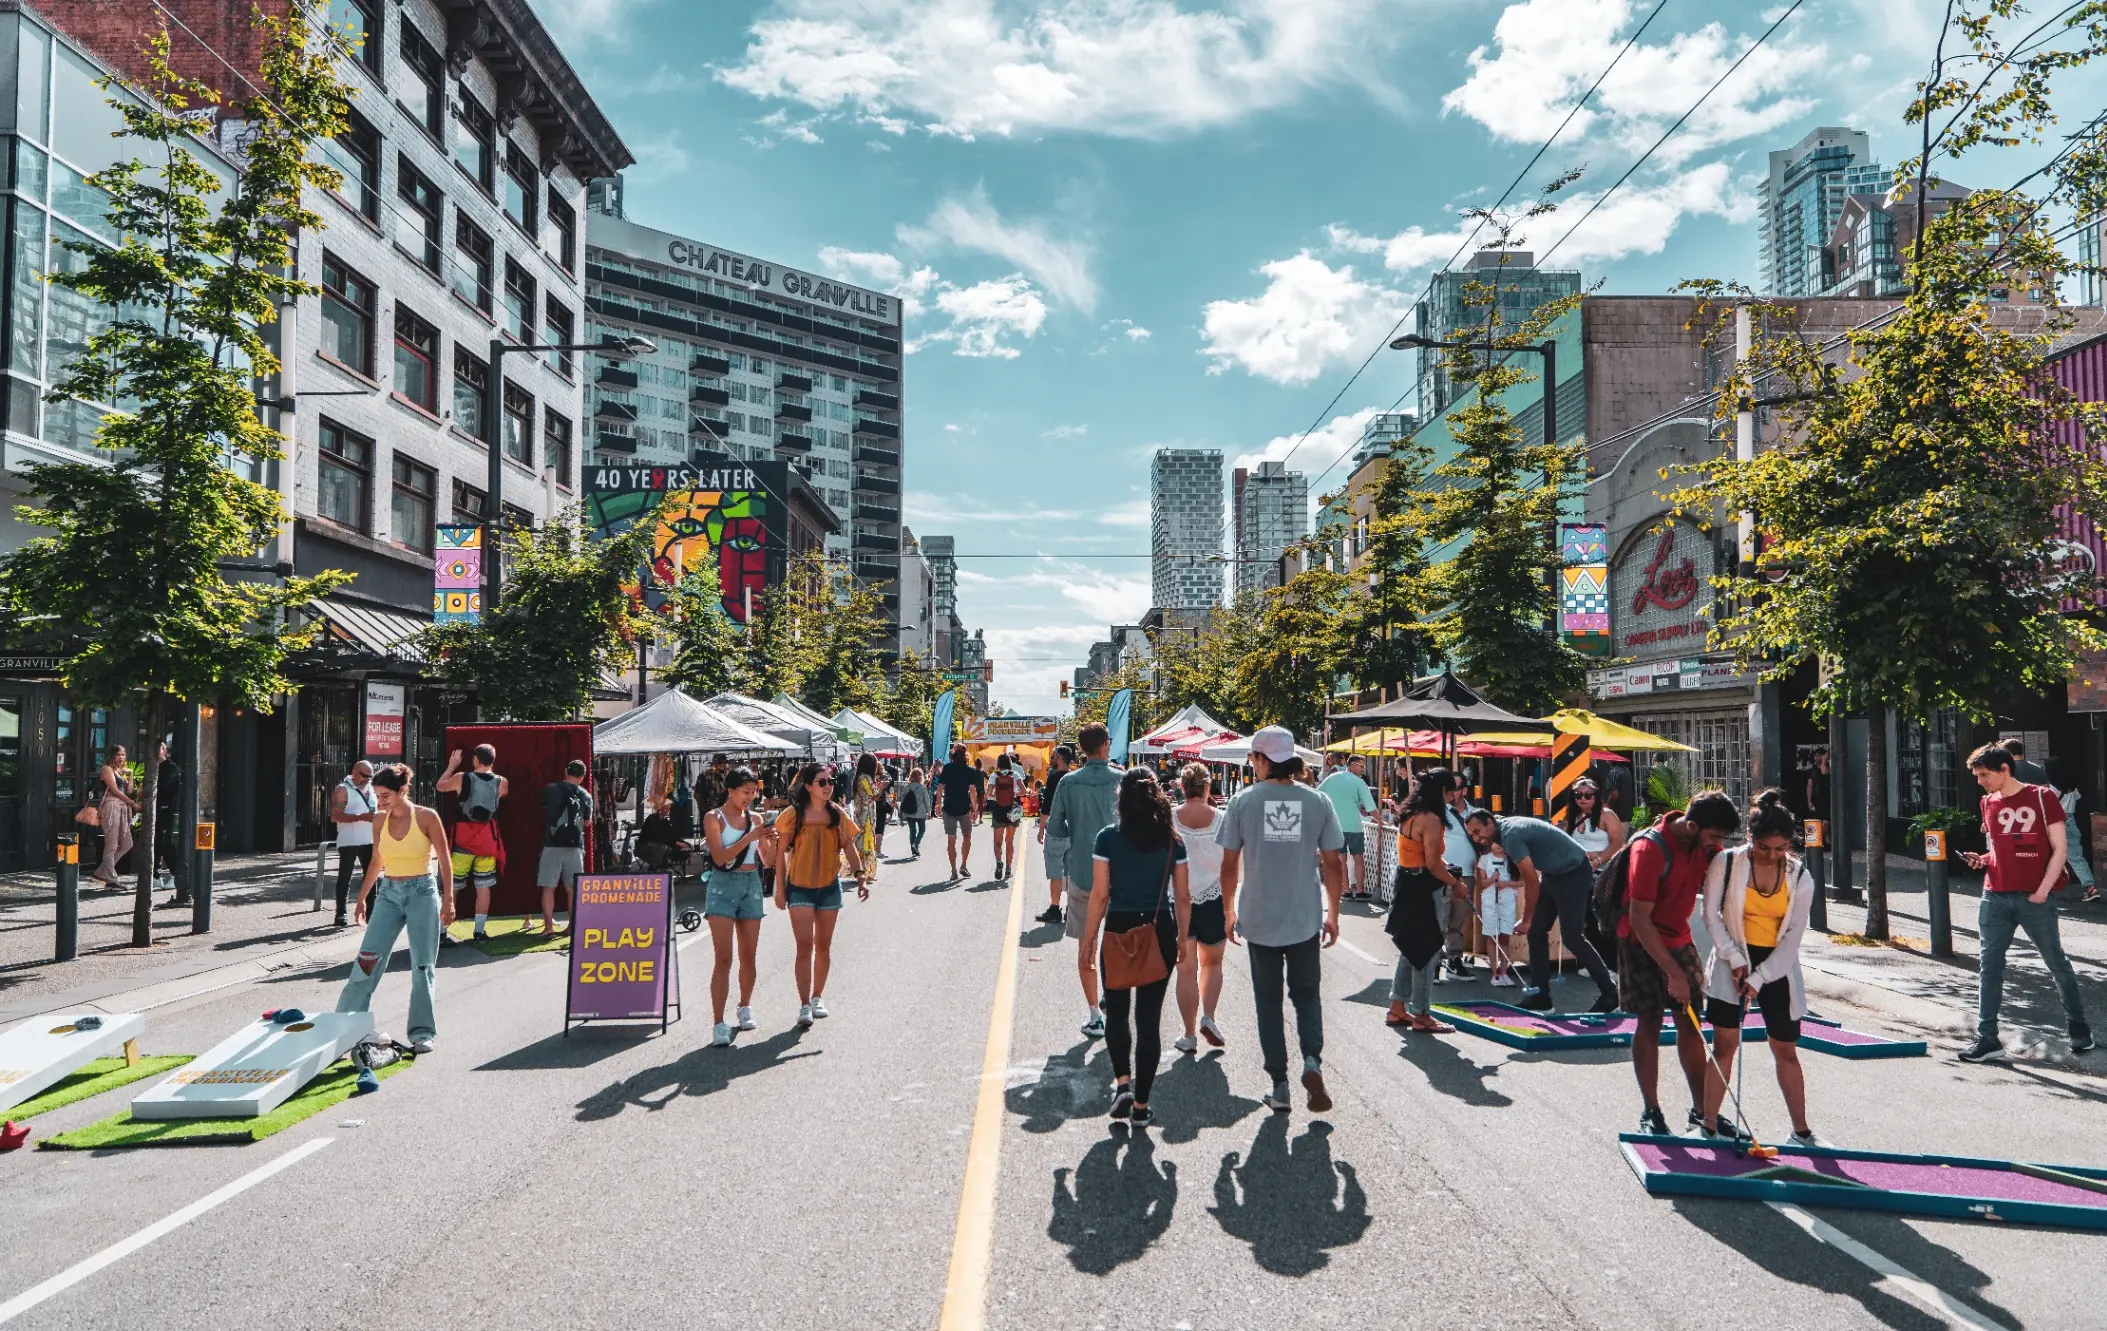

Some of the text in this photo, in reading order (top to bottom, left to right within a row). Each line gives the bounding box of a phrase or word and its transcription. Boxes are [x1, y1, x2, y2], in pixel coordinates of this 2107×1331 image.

[668, 240, 888, 318] CHATEAU GRANVILLE
[595, 469, 621, 489] 40
[698, 468, 755, 489] LATER
[1656, 661, 1675, 673] RICOH
[1701, 666, 1735, 677] PLANE
[1629, 675, 1650, 686] Canon
[1608, 684, 1624, 695] SIGMA
[368, 721, 401, 734] FOR LEASE
[1998, 806, 2037, 834] 99
[581, 891, 661, 904] PROMENADE
[584, 927, 655, 949] PLAY
[580, 961, 655, 983] ZONE
